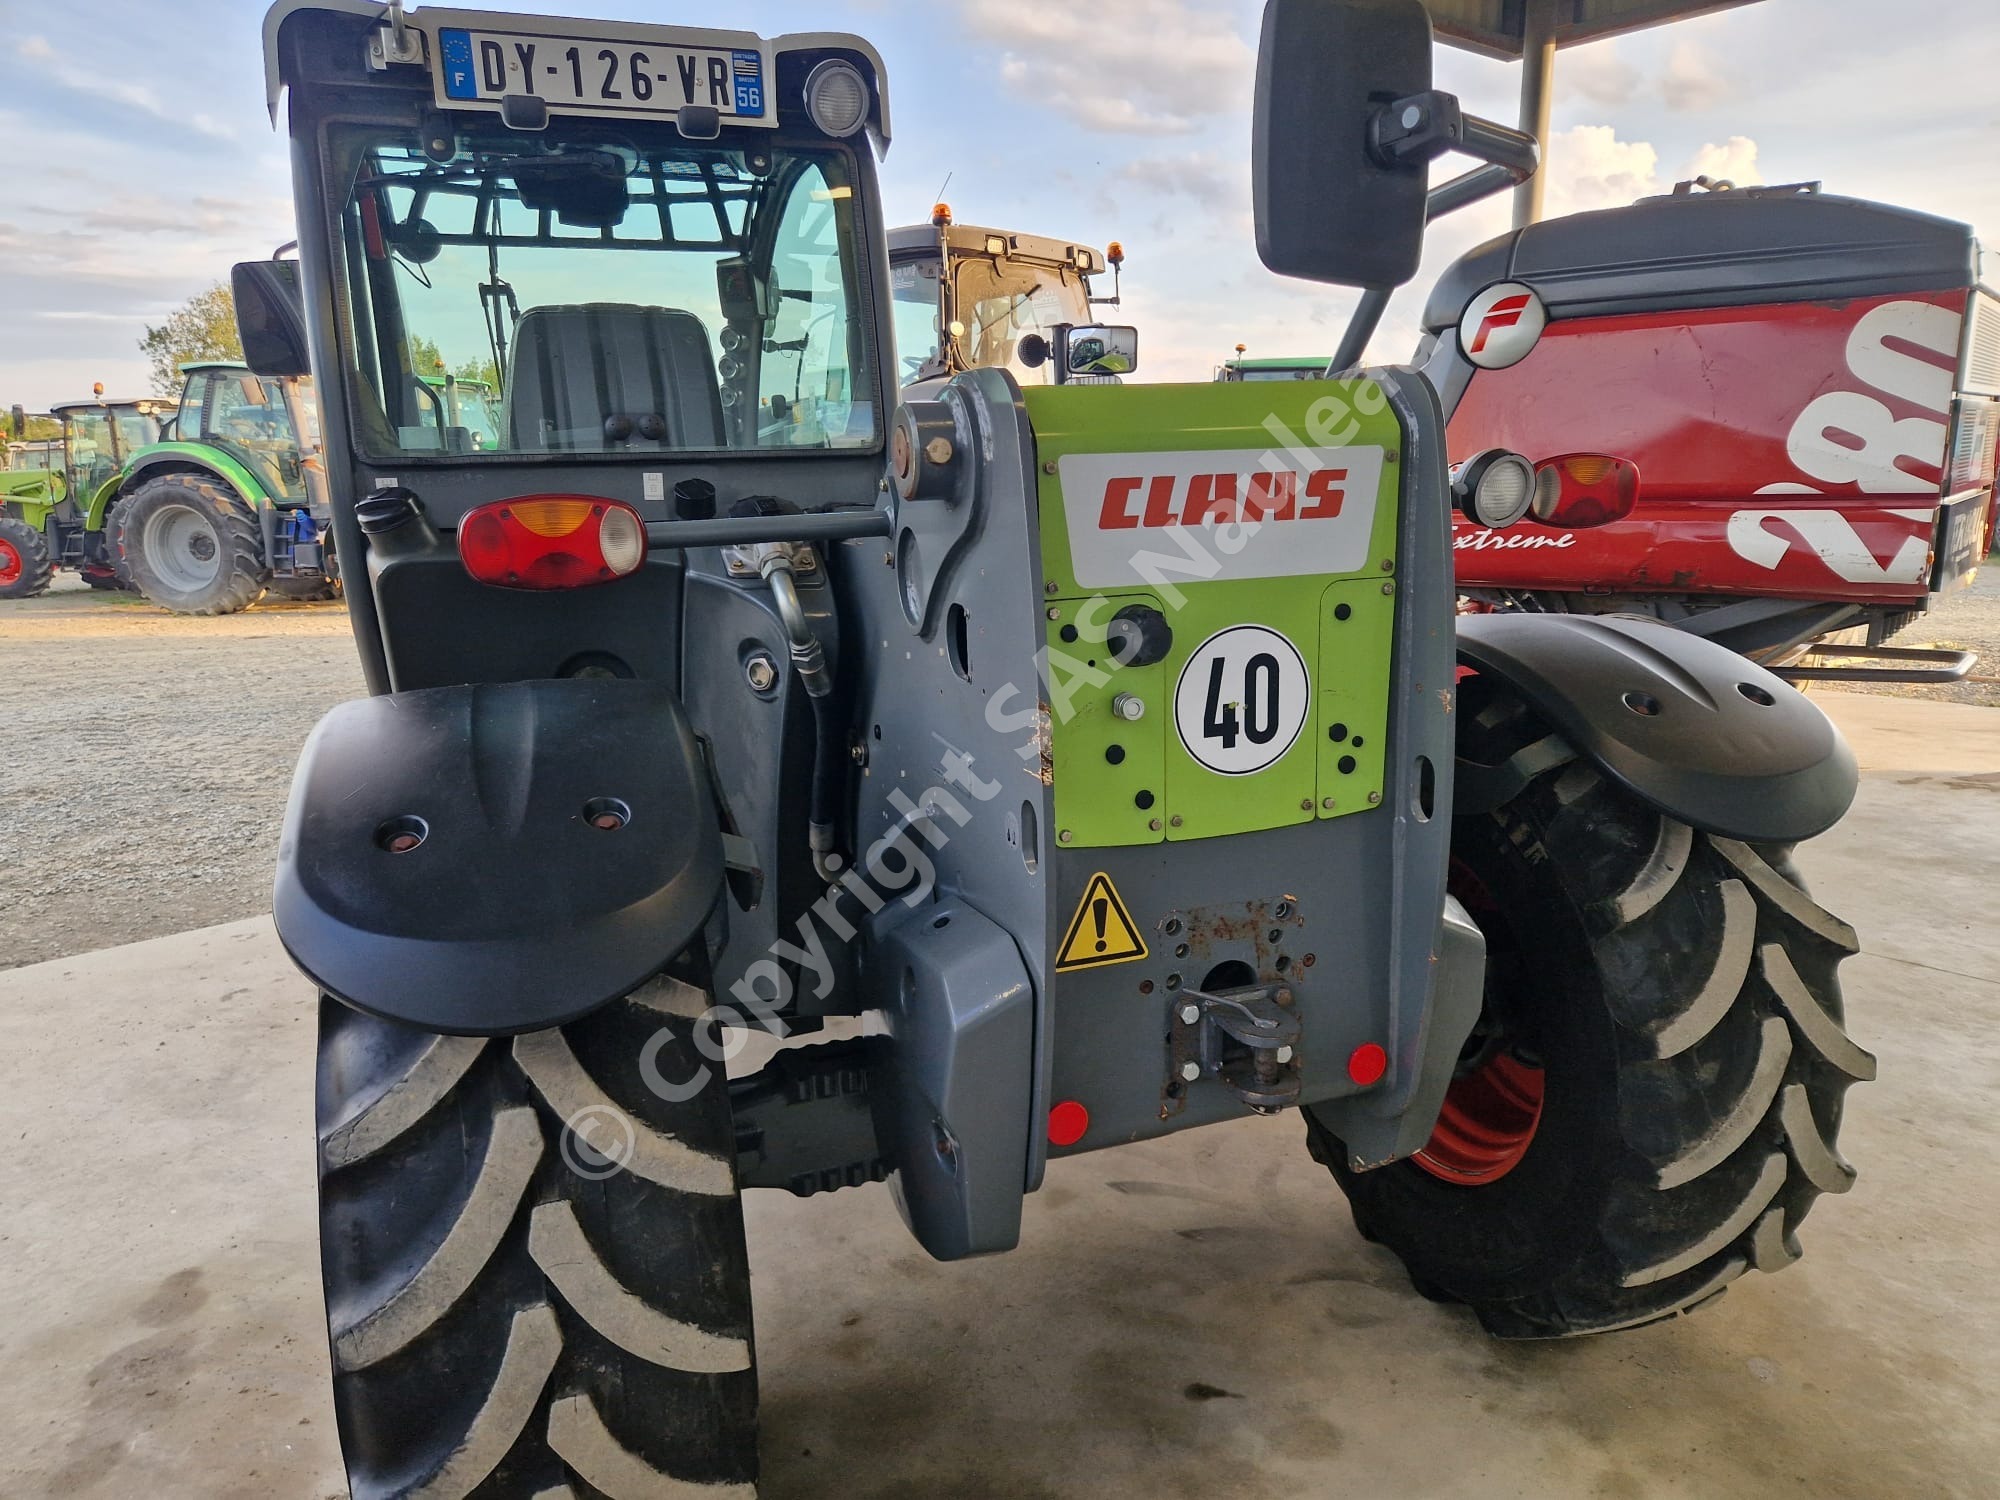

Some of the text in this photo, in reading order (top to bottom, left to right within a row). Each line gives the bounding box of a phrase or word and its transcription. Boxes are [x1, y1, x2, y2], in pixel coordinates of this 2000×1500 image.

[454, 72, 464, 87] F
[480, 40, 730, 106] DY-126-VR
[737, 86, 760, 108] 56
[1098, 468, 1348, 530] CLAAS
[1452, 525, 1577, 550] xtreme
[1203, 652, 1280, 749] 40
